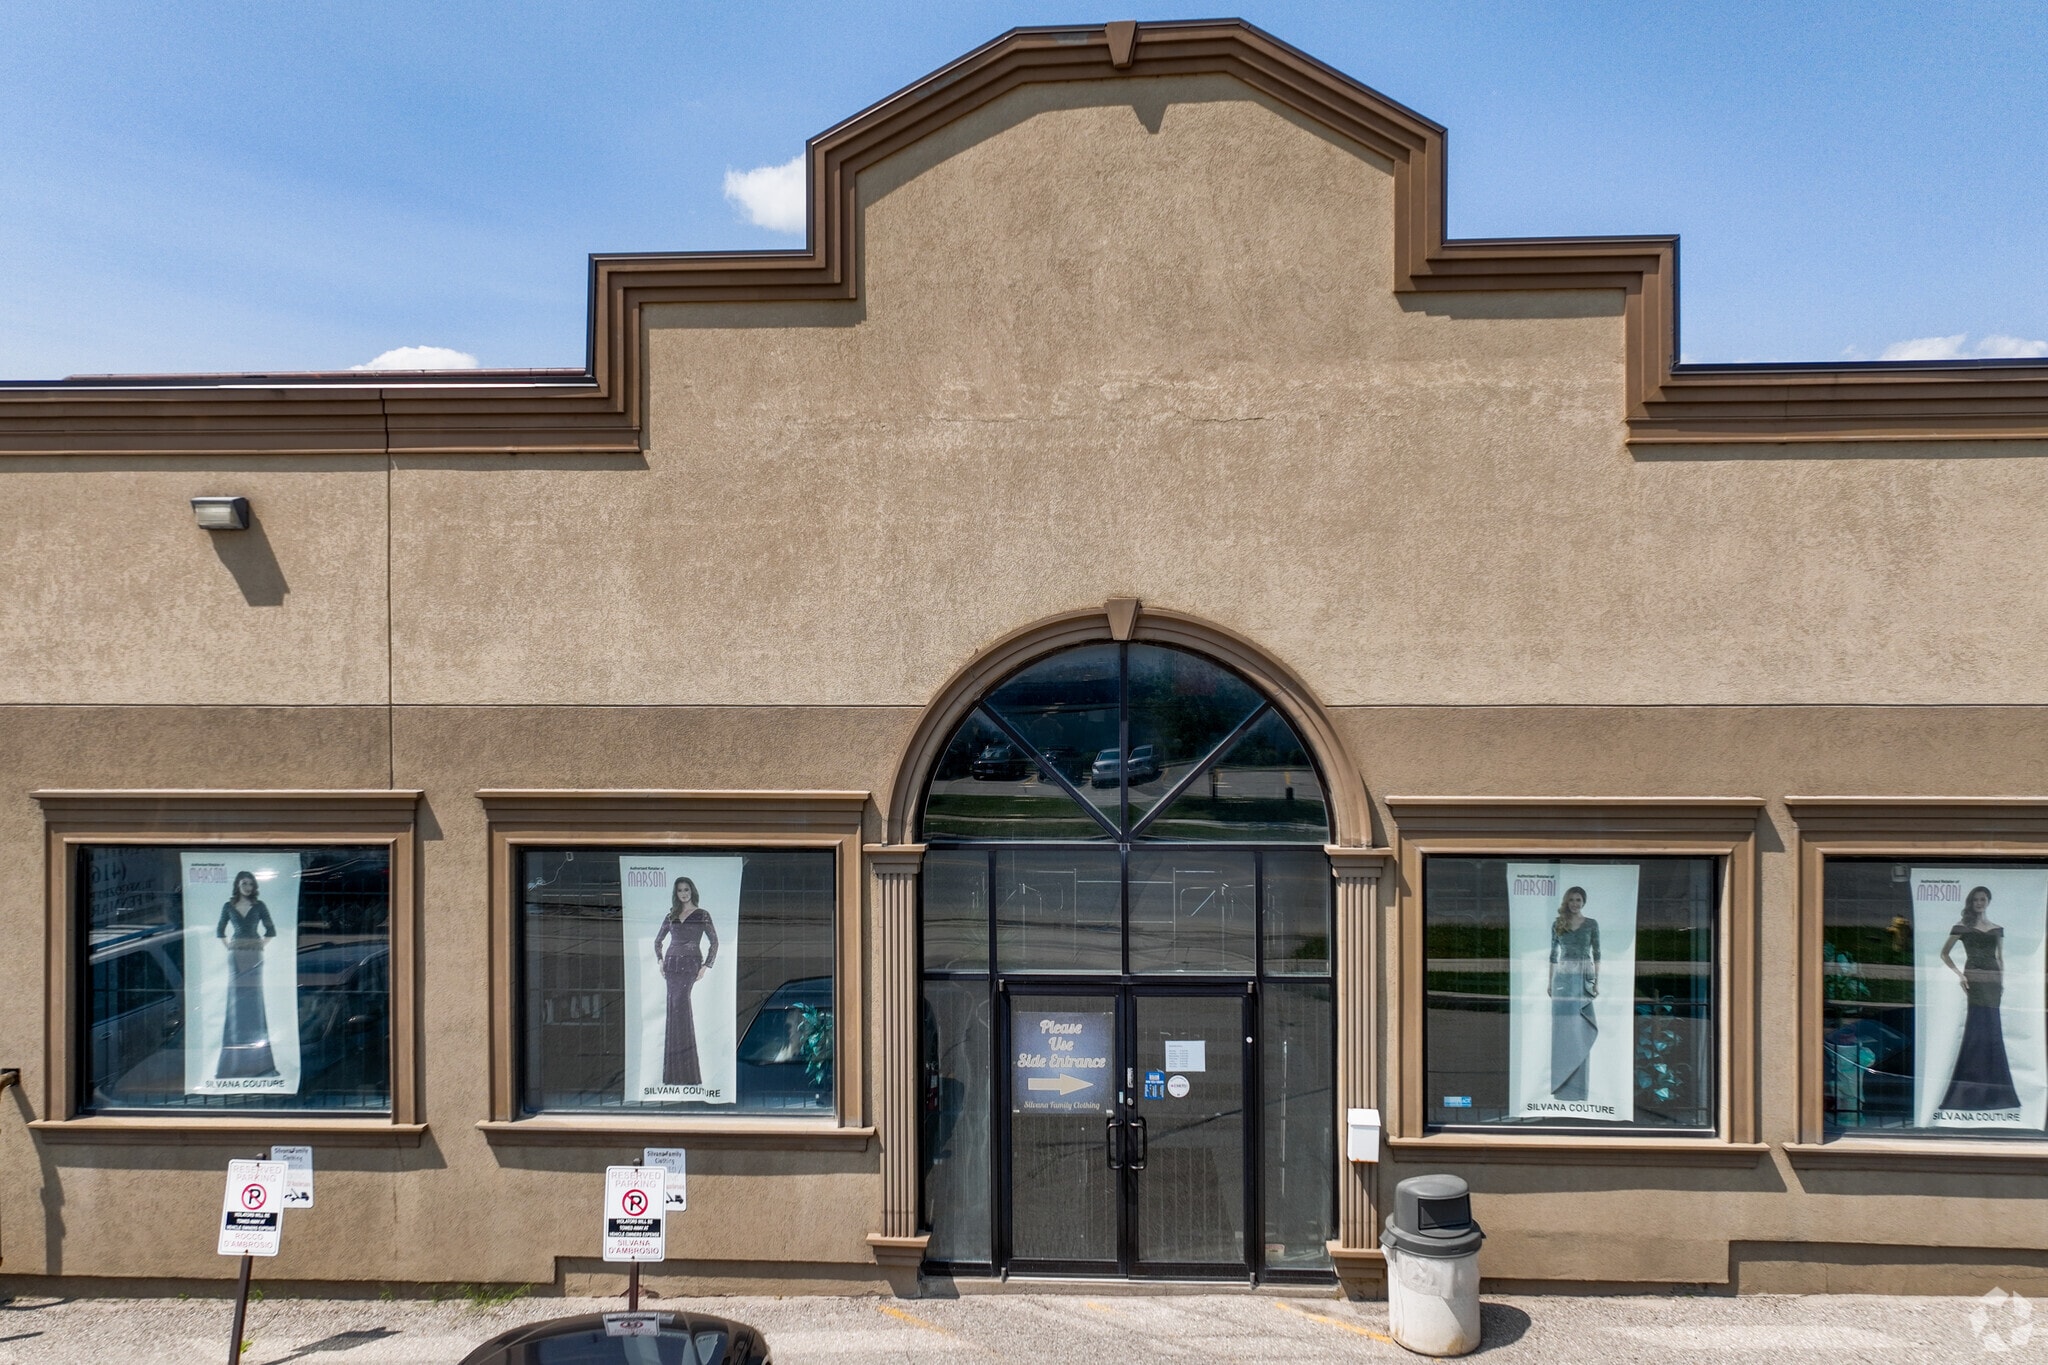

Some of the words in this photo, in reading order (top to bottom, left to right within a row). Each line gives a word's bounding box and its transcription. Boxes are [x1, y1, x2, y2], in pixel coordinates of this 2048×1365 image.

[628, 871, 667, 888] MARSONI
[1513, 879, 1556, 896] MARSONI
[1917, 884, 1961, 902] MARSONI
[1040, 1019, 1083, 1034] Please
[1048, 1036, 1074, 1051] Use
[1017, 1053, 1047, 1068] Side
[1049, 1053, 1106, 1068] Entrance
[644, 1087, 681, 1095] SILVANA
[1024, 1101, 1049, 1109] Silvana
[1050, 1101, 1072, 1110] Family
[1073, 1101, 1101, 1110] Clothing
[1527, 1103, 1567, 1112] SILVANA
[1569, 1104, 1615, 1114] COUTURE
[1932, 1112, 1975, 1121] SILVANA
[1976, 1112, 2021, 1121] COUTURE
[233, 1165, 282, 1174] RESERVED
[237, 1174, 276, 1182] PARKING
[611, 1171, 661, 1180] RESERVED
[616, 1180, 656, 1188] PARKING
[608, 1247, 659, 1255] D'AMBROSIO
